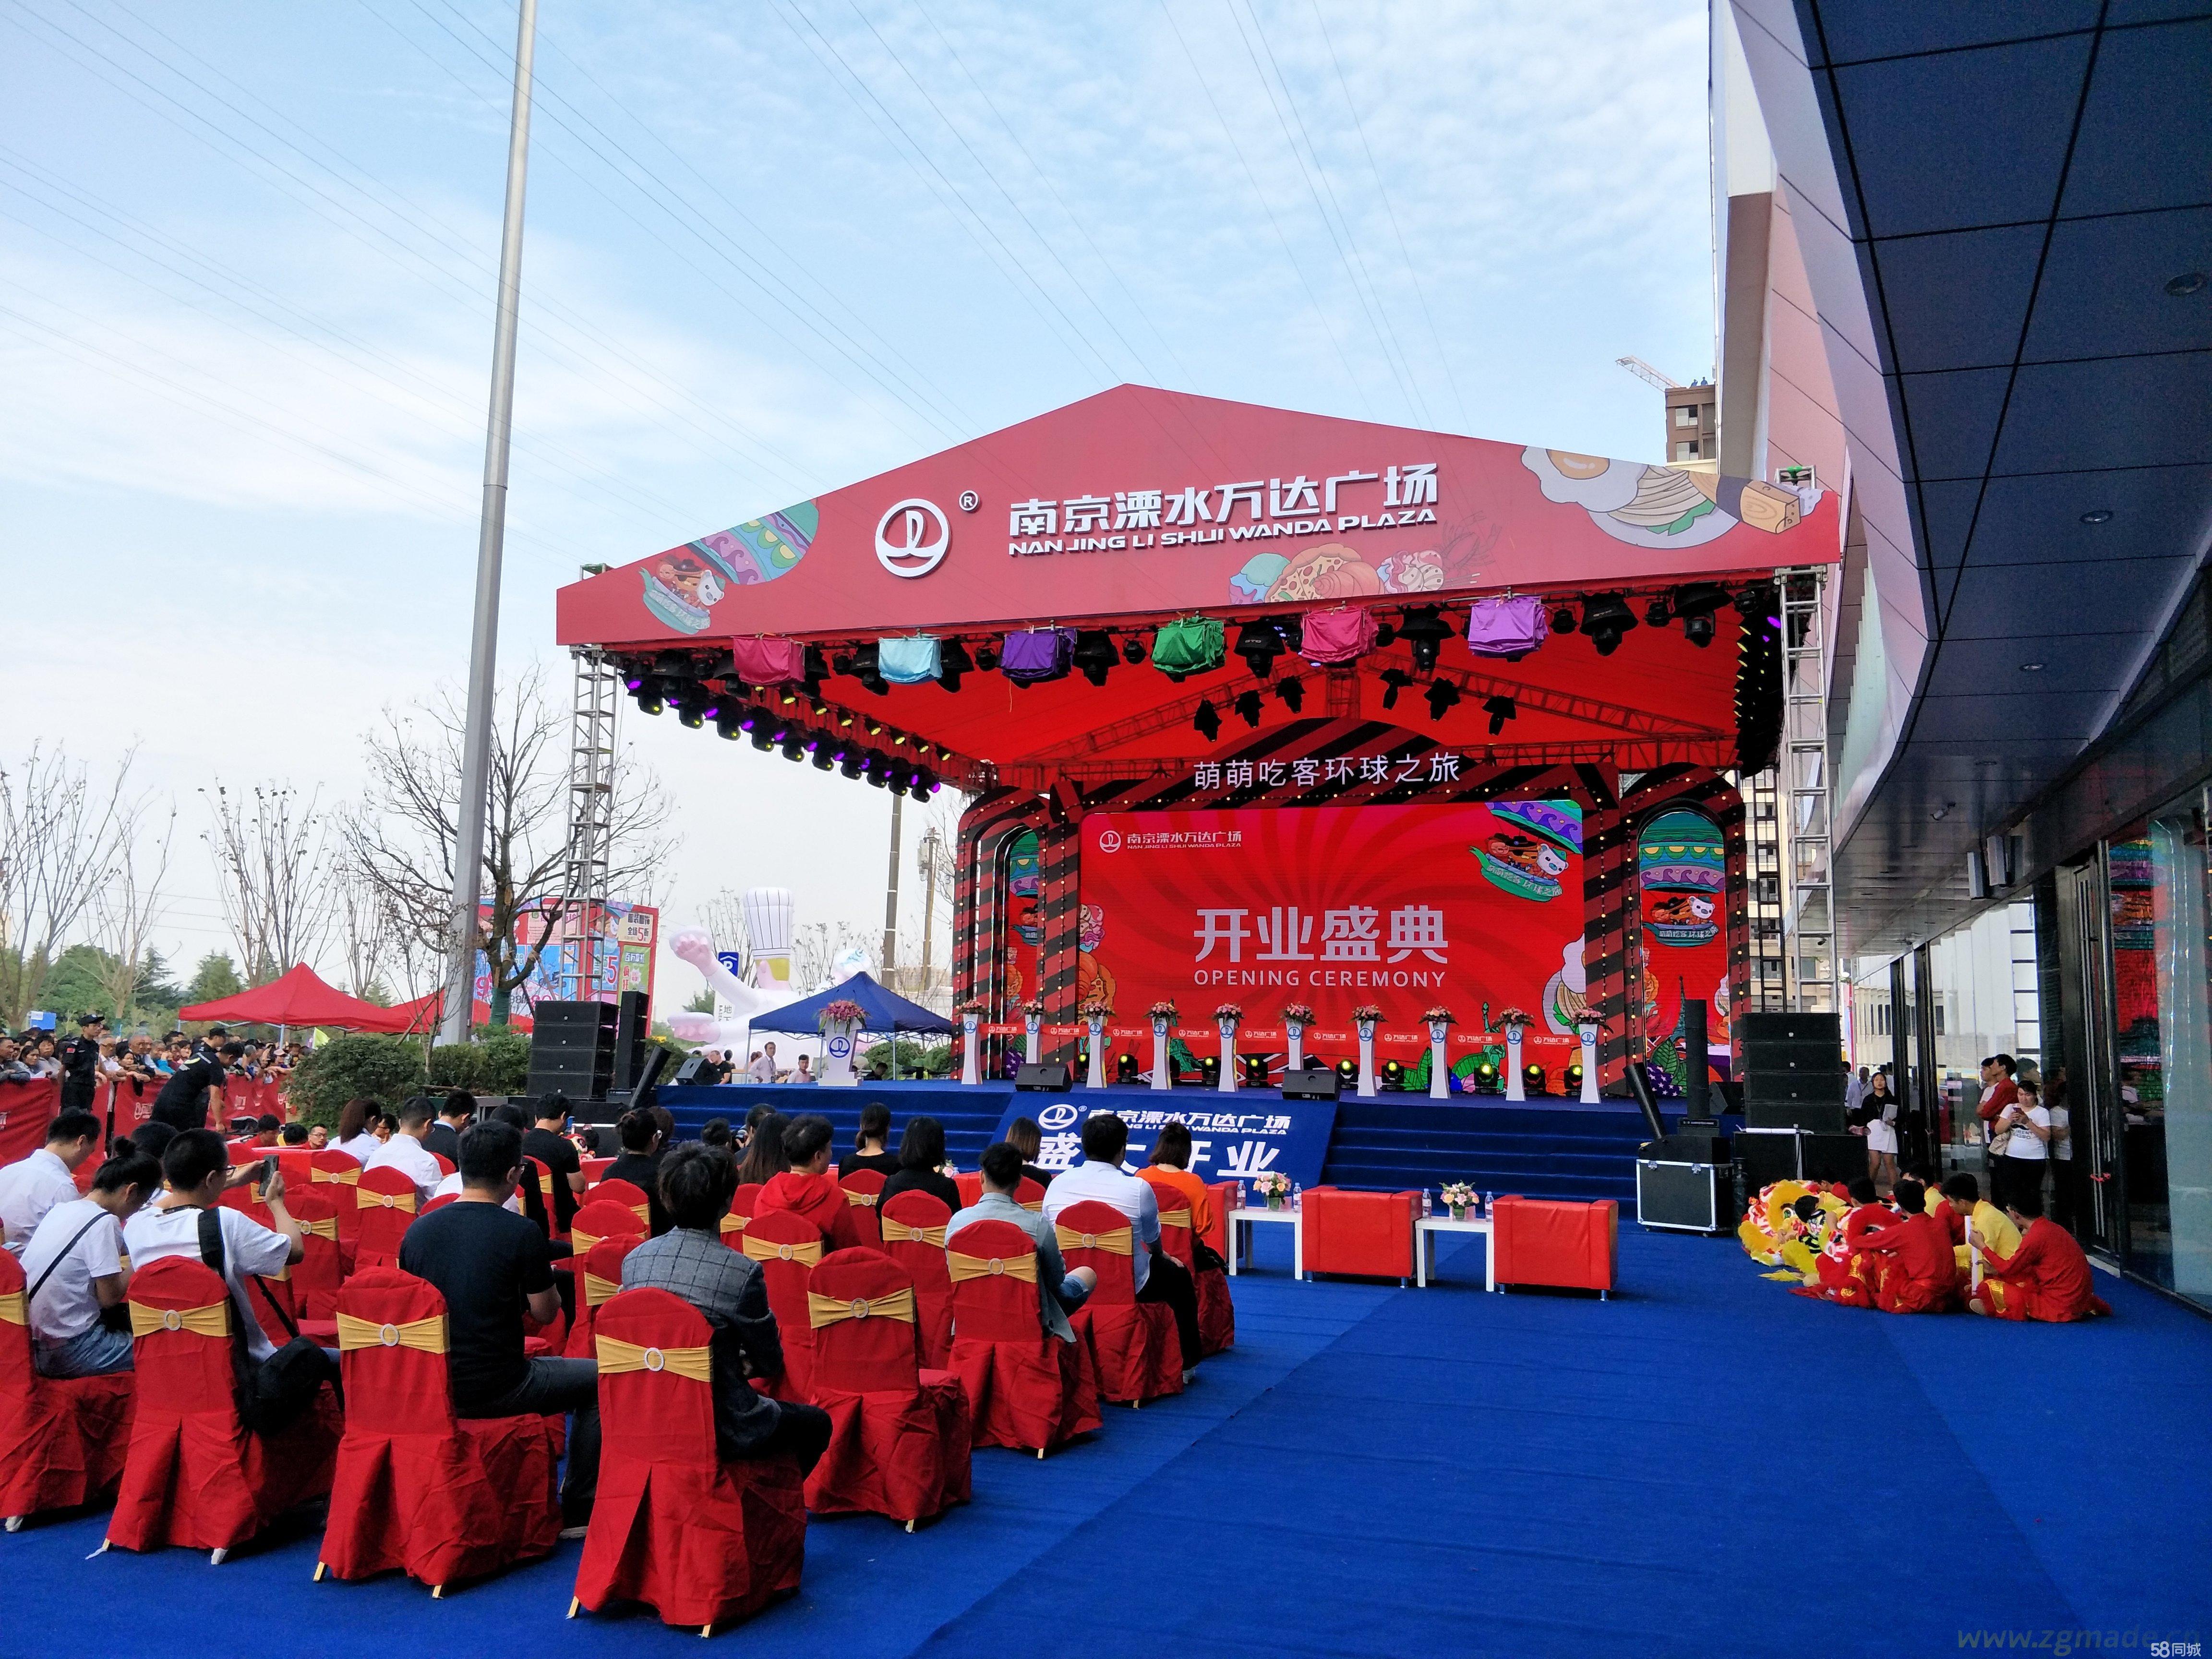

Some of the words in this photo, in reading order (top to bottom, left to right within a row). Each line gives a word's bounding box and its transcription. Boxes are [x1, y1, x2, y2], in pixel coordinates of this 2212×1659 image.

[1010, 463, 1437, 537] 南京溧水万达广场
[1009, 539, 1062, 555] NAN
[1066, 535, 1126, 551] JING
[1132, 534, 1154, 547] LI
[1161, 529, 1224, 546] SHUI
[1228, 519, 1332, 540] WANDA
[1338, 509, 1437, 531] PLAZA
[1193, 752, 1461, 791] 萌萌吃客环球之旅
[1127, 831, 1242, 844] 南京溧水万达广场
[1193, 905, 1448, 964] 开业盛典
[1194, 969, 1299, 986] OPENING
[1309, 970, 1446, 987] CEREMONY
